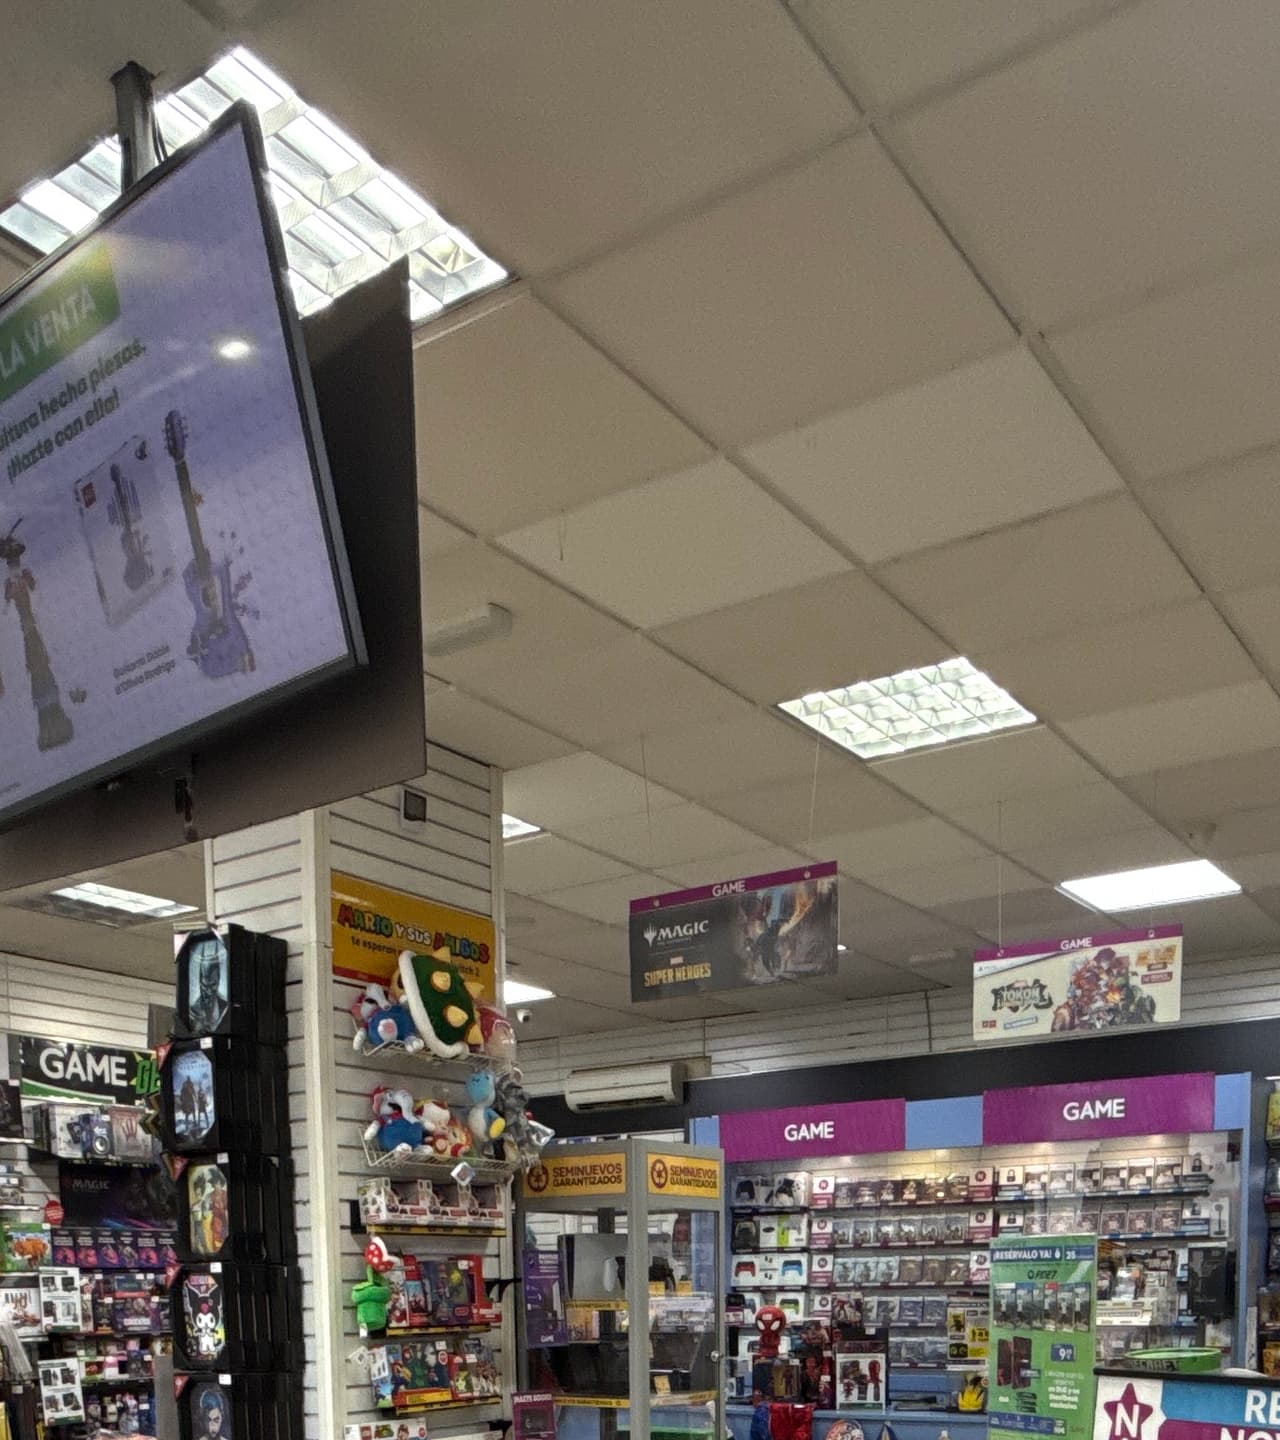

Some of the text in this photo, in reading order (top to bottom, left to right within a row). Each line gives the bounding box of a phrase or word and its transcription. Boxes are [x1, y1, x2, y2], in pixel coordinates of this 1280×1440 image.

[25, 284, 97, 355] VENTA
[40, 377, 89, 426] hecha
[712, 880, 746, 897] GAME
[337, 904, 490, 964] MARIO Y SUS AMIGOS
[657, 920, 709, 941] MAGIC
[1060, 937, 1093, 950] GAME
[644, 963, 712, 987] SUPER HEROES
[40, 1047, 127, 1087] GAME
[1062, 1097, 1125, 1122] GAME
[784, 1120, 835, 1143] GAME
[553, 1163, 622, 1177] SEMINUEVOS
[553, 1175, 622, 1187] GARANTIZADOS
[670, 1167, 717, 1179] SEMINUEVOS
[670, 1178, 717, 1189] GARANTIZADOS
